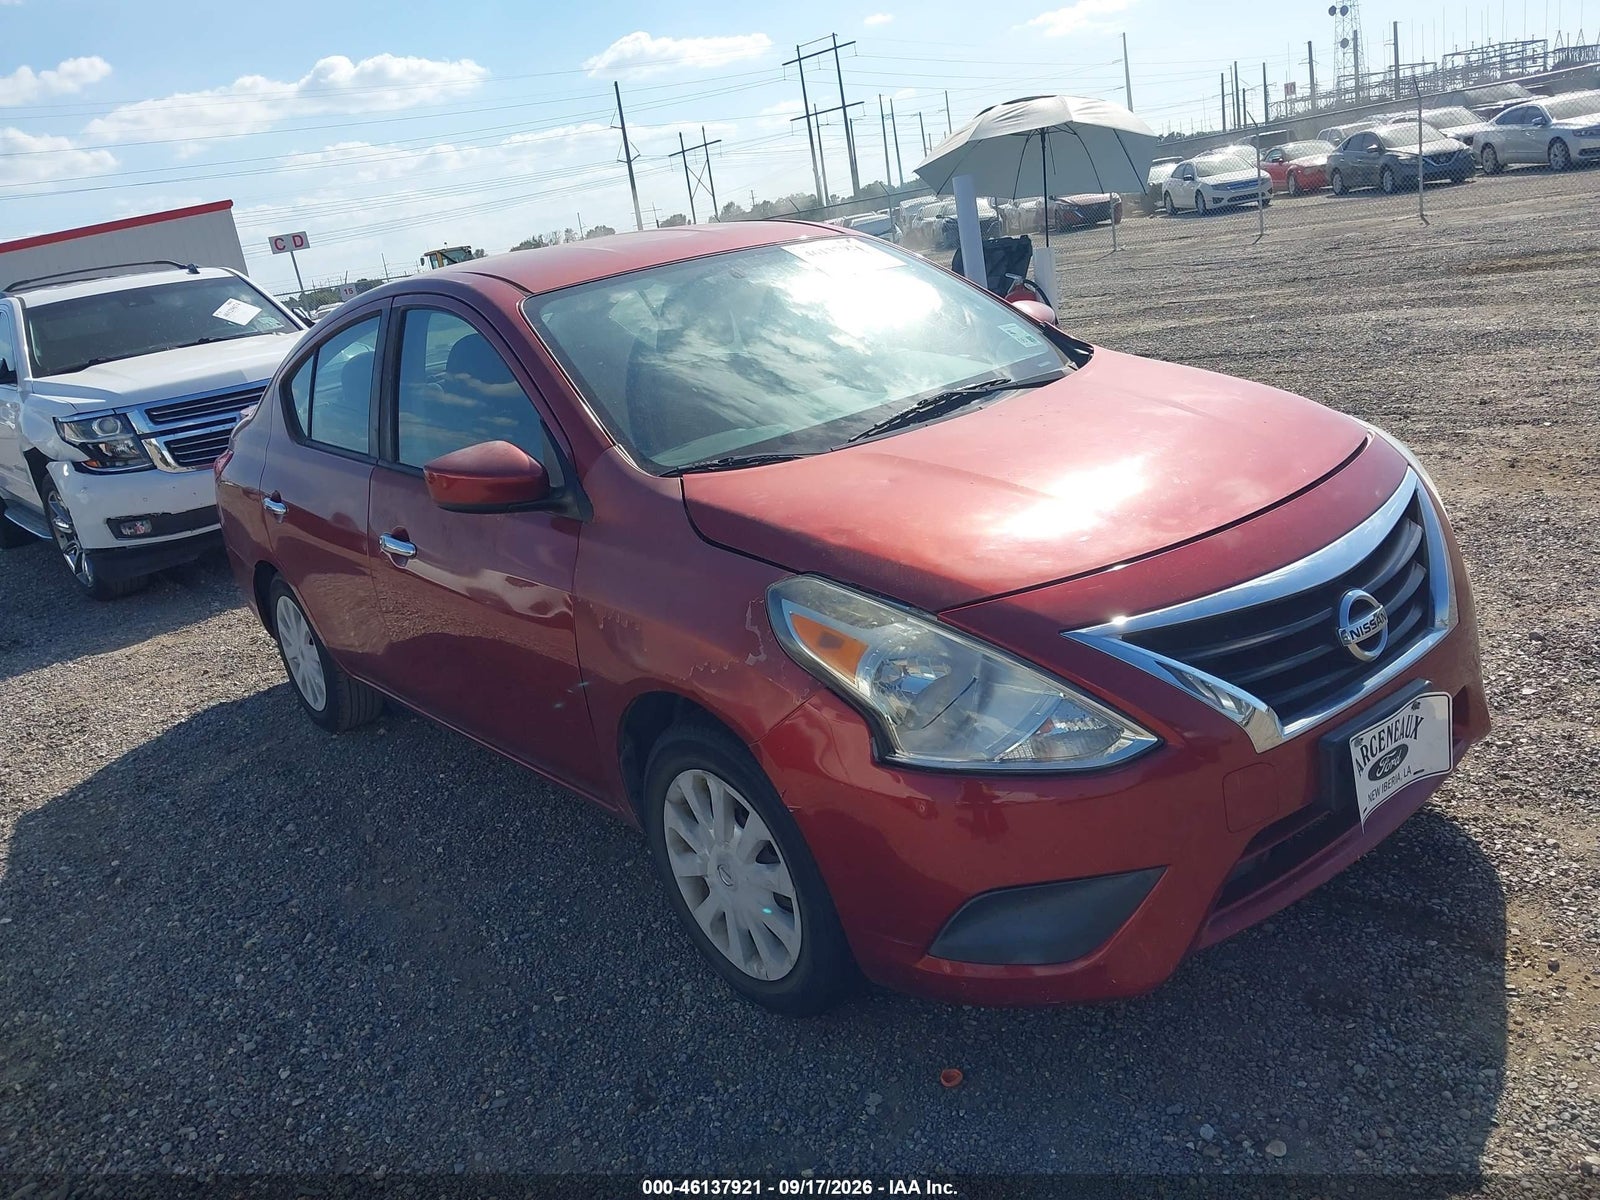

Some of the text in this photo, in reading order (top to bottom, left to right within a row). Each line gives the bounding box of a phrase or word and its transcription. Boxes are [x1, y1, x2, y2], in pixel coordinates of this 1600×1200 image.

[274, 234, 304, 251] C D
[343, 287, 354, 295] 15
[1349, 611, 1387, 640] NISSAN
[1355, 714, 1424, 777] ARCENEAUX
[1375, 748, 1404, 777] Ford
[1367, 765, 1412, 804] NEW IBERIA, LA
